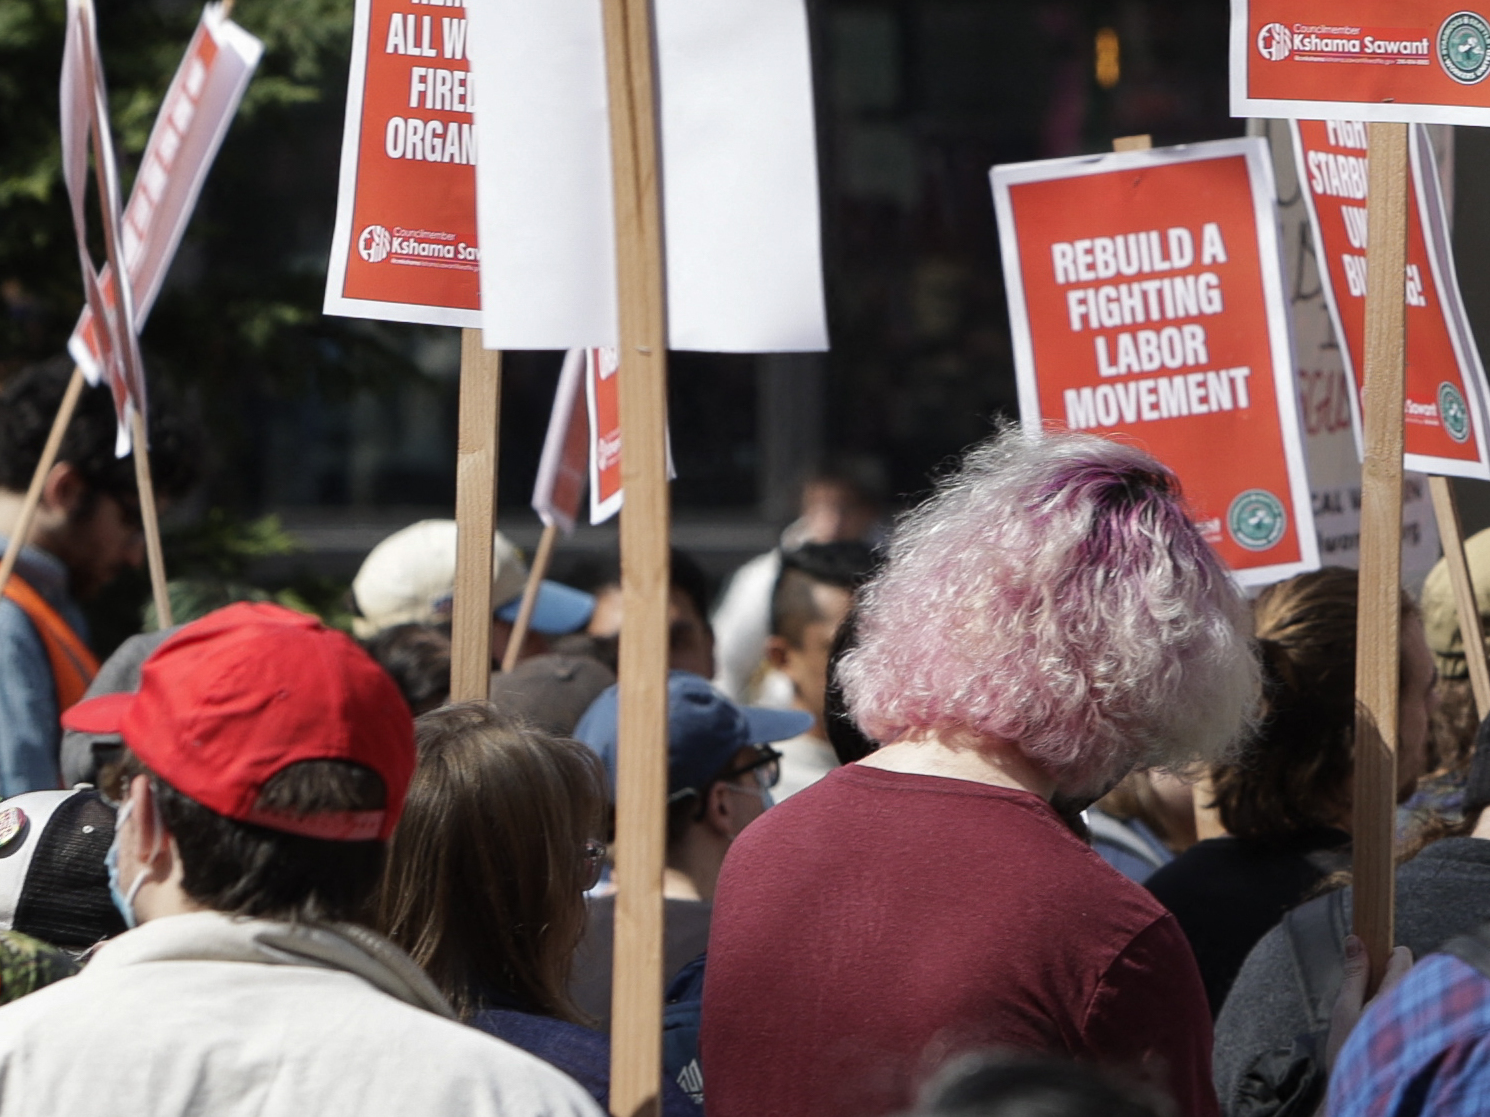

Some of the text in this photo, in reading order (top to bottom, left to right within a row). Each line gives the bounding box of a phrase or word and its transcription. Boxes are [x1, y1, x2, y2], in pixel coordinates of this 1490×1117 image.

[385, 12, 437, 58] ALL
[1293, 33, 1429, 55] Kshama Sawant
[391, 237, 454, 258] Kshama
[1051, 222, 1228, 285] REBUILD A
[1066, 273, 1223, 332] FIGHTING
[1094, 324, 1207, 379] LABOR
[1063, 367, 1251, 430] MOVEMENT
